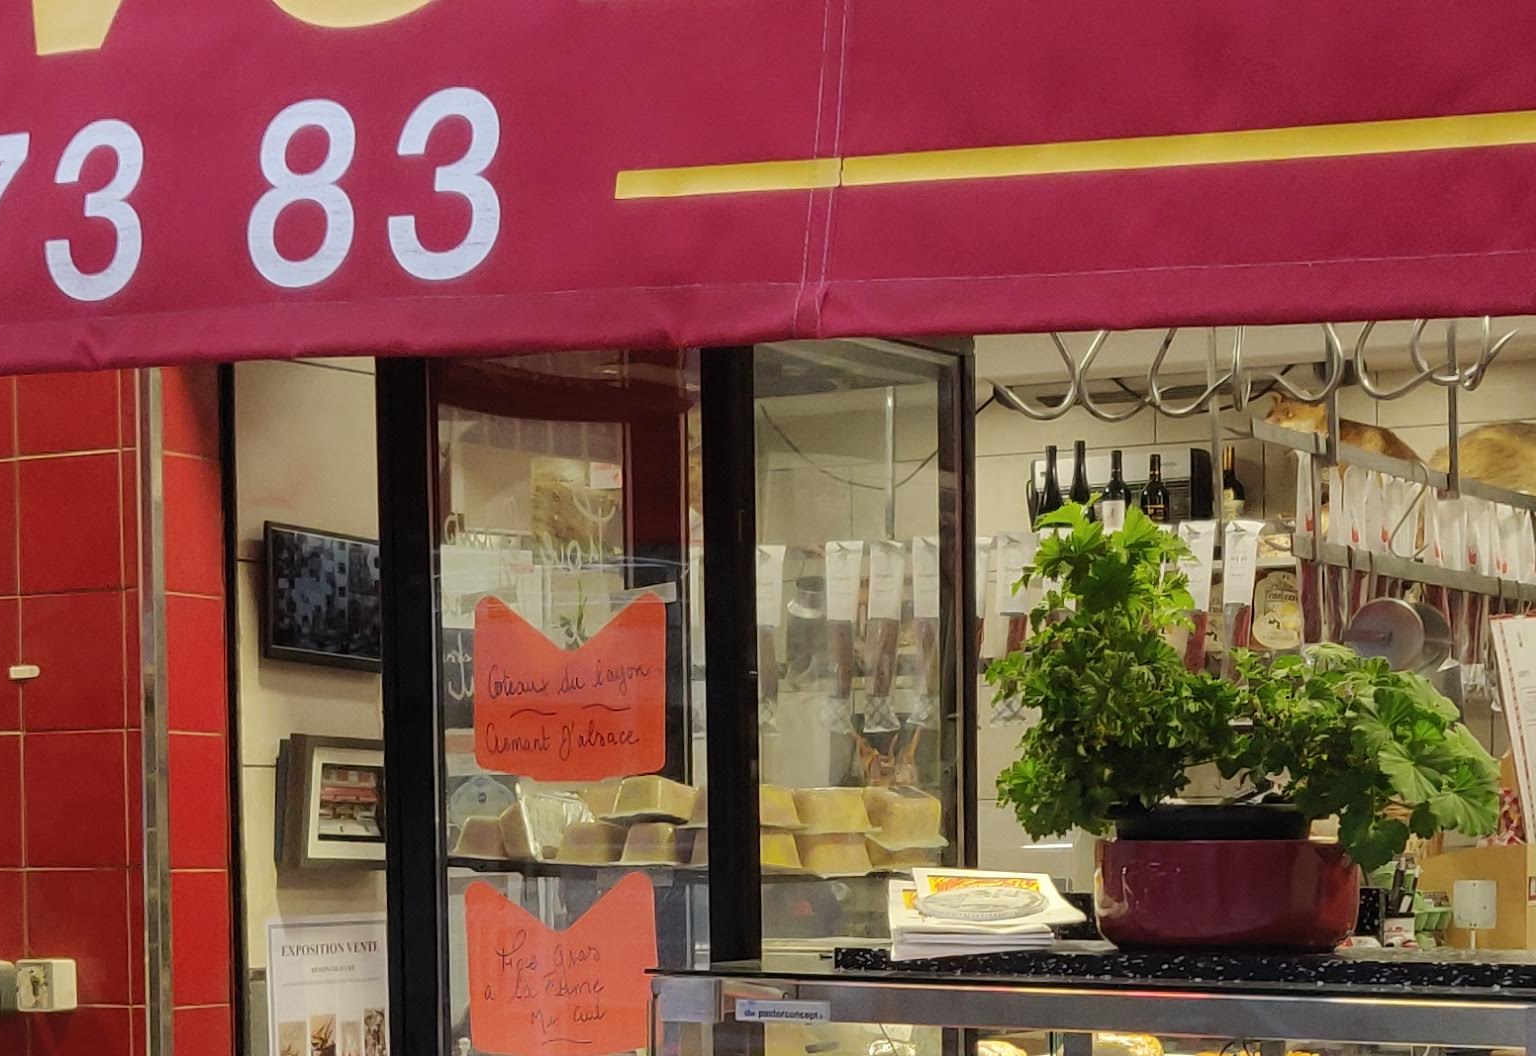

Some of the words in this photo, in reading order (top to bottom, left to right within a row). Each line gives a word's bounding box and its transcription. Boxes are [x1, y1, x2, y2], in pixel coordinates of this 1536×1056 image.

[246, 87, 501, 288] 83
[558, 662, 585, 695] du
[281, 942, 345, 958] EXPOSITION
[346, 940, 379, 953] VENTE
